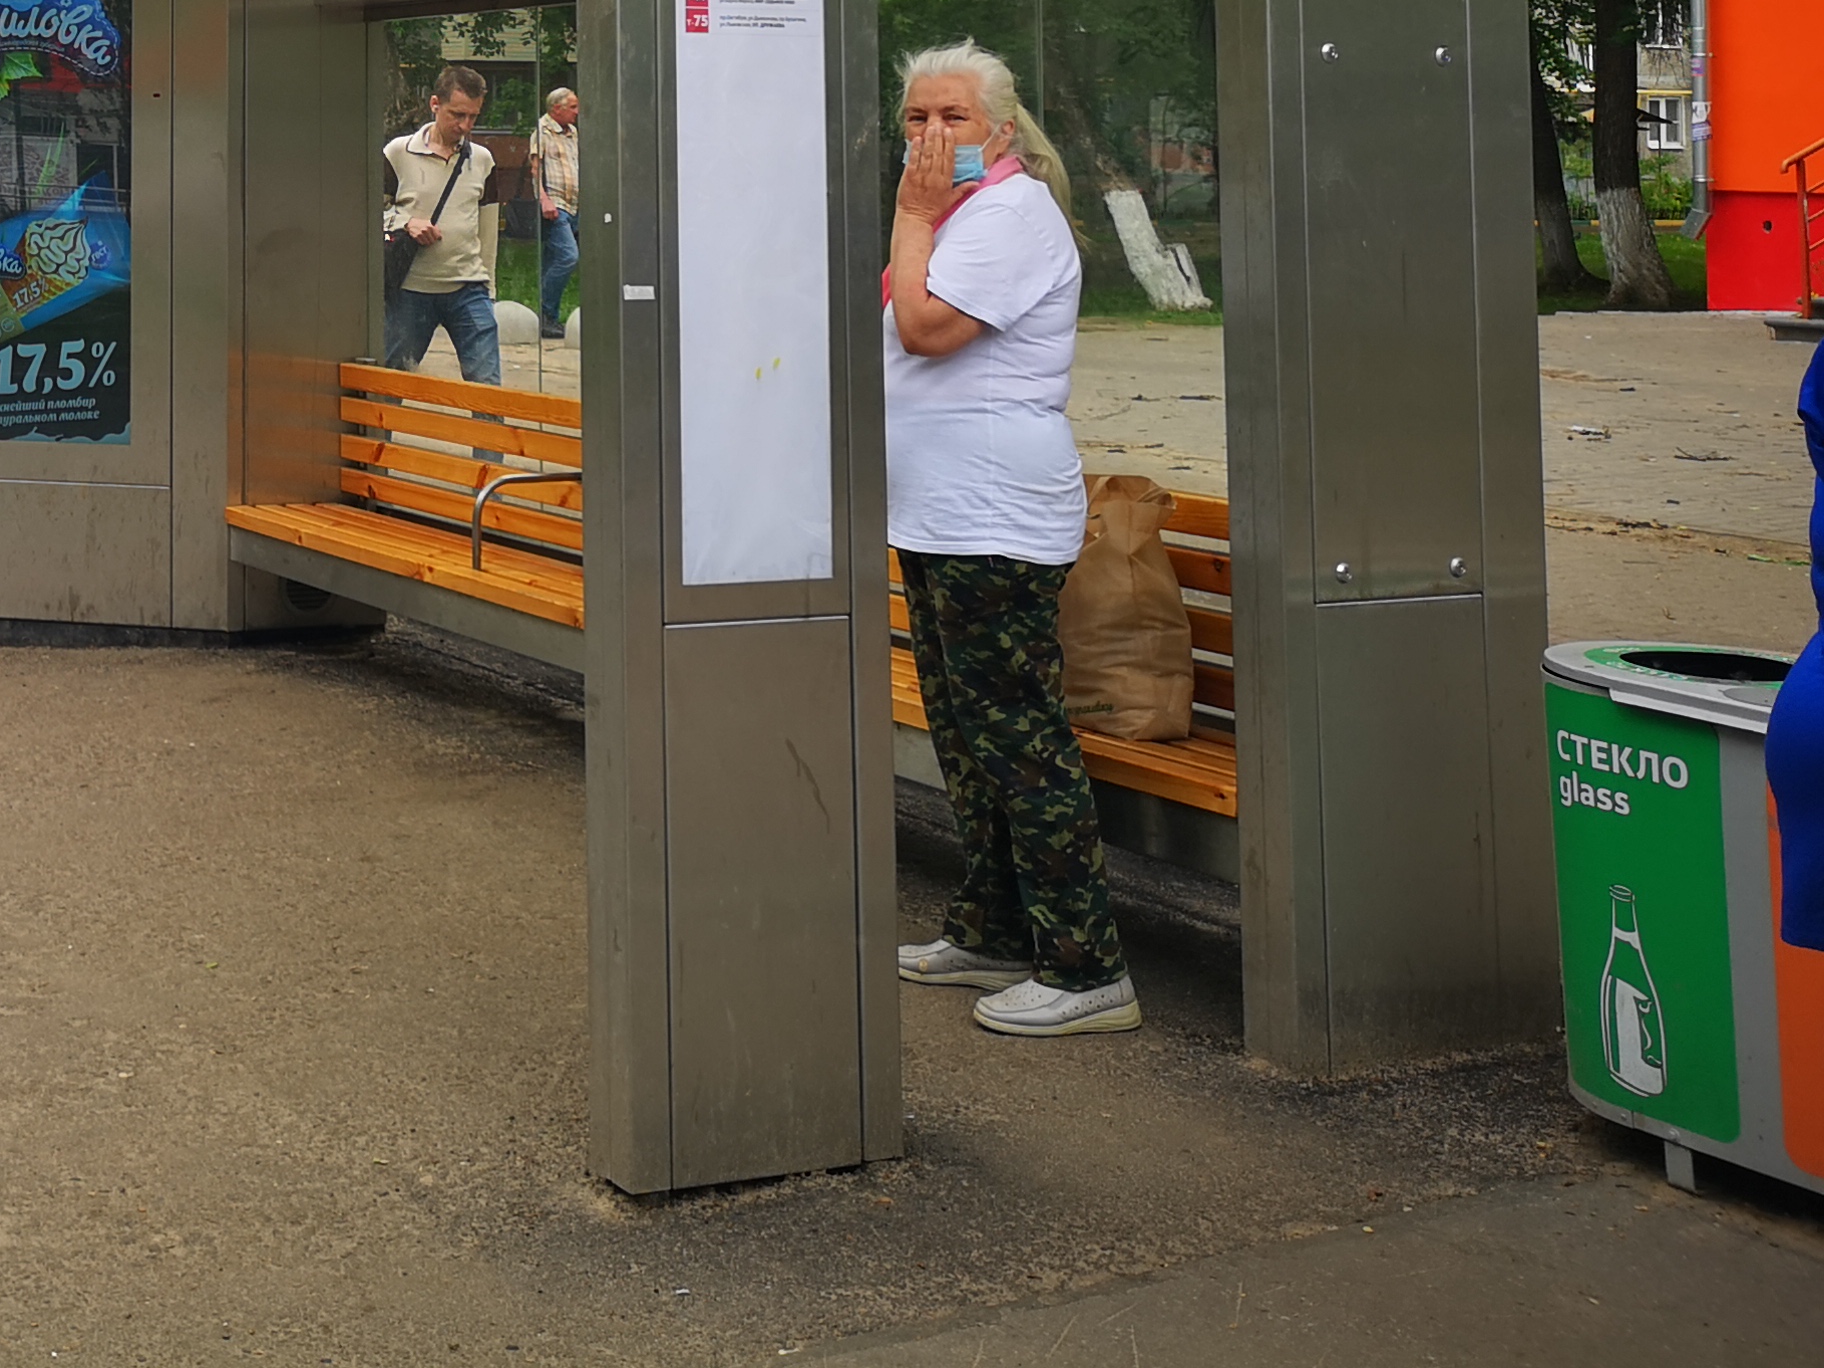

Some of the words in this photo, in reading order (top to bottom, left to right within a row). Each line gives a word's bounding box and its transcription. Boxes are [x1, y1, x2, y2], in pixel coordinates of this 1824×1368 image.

[47, 396, 96, 411] пломбир
[58, 409, 100, 422] молоке
[1556, 729, 1689, 789] СТЕКЛО
[1559, 771, 1631, 816] glass
